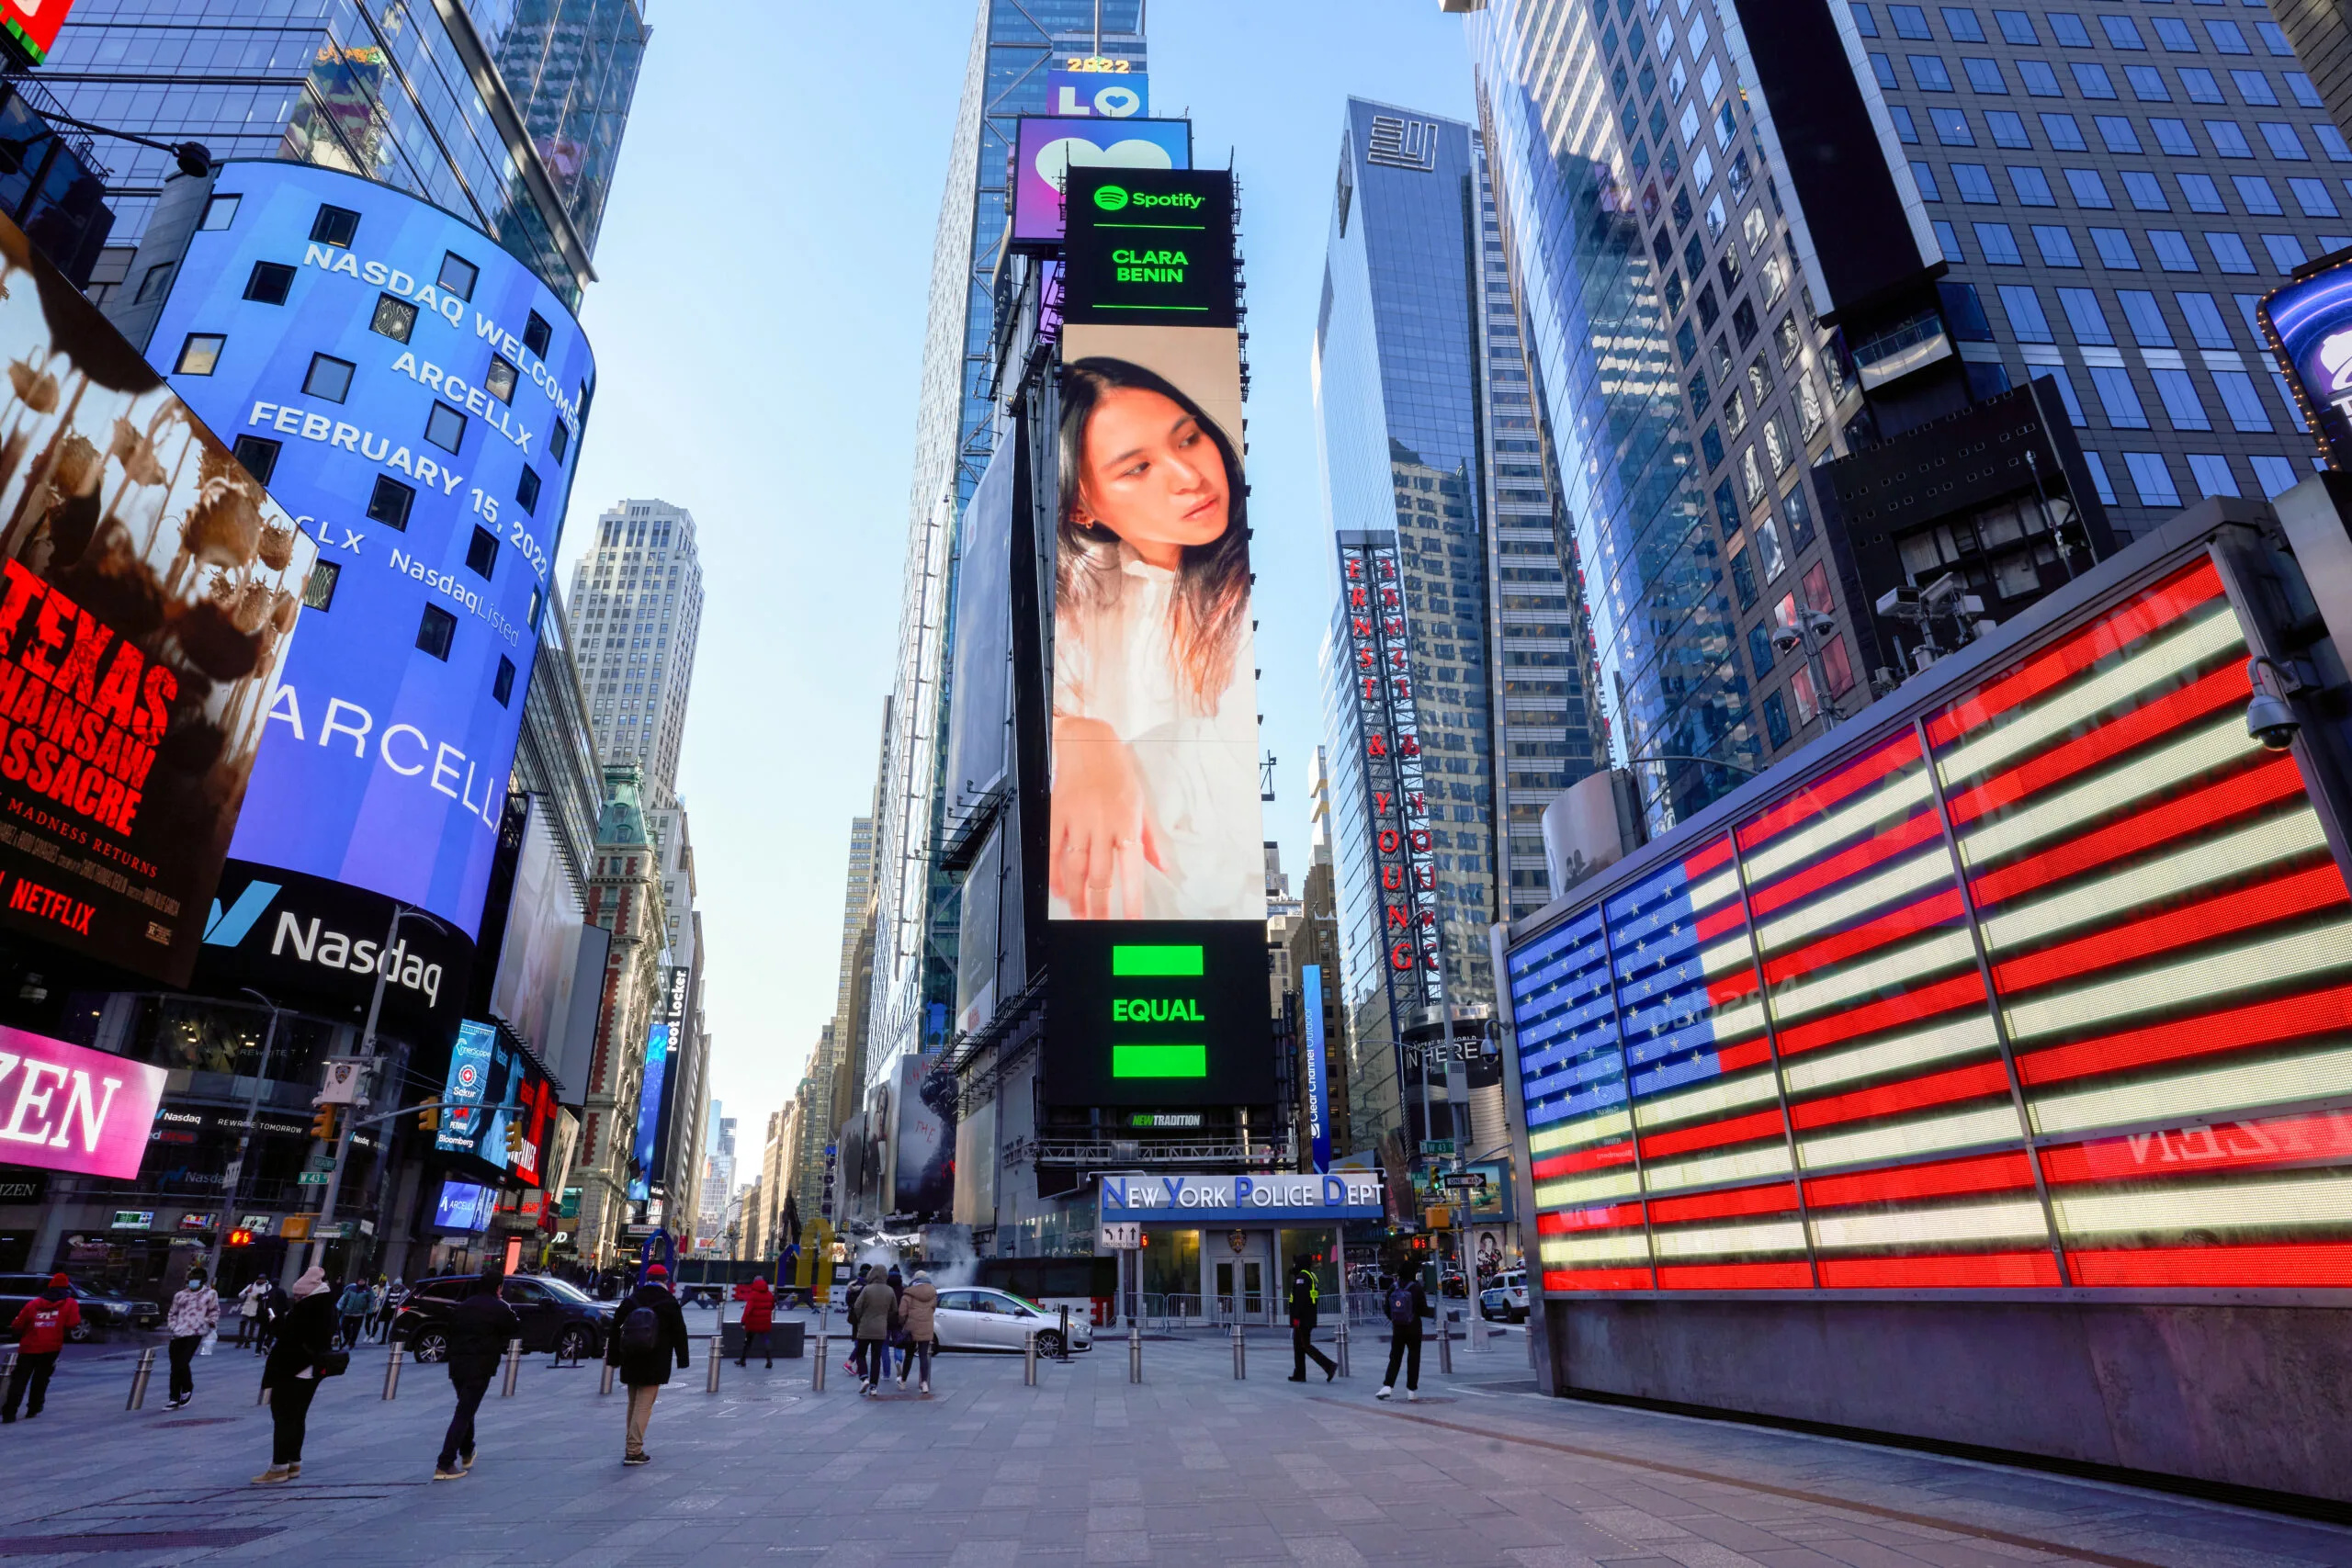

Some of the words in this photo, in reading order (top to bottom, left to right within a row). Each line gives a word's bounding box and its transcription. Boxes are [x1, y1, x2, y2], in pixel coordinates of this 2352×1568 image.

[1067, 57, 1130, 74] 2022
[1132, 193, 1202, 209] Spotify
[1112, 249, 1189, 265] CLARA
[1117, 267, 1183, 283] BENIN
[303, 243, 464, 328] NASDAQ
[475, 311, 581, 442] WELCOMES
[390, 352, 533, 455] ARCELLX
[248, 400, 463, 496] FEBRUARY
[470, 488, 503, 534] 15,
[510, 521, 550, 583] 2022
[1349, 558, 1377, 699] ERNST
[0, 557, 178, 747] TEXAS
[1368, 733, 1386, 756] &
[0, 716, 142, 837] SSACRE
[7, 797, 88, 844] MADNESS
[92, 838, 158, 879] RETURNS
[1375, 793, 1412, 970] YOUNG
[9, 877, 96, 936] NETFLIX
[271, 910, 444, 1008] Nasdaq
[668, 970, 687, 1017] Locker.
[1113, 998, 1204, 1022] EQUAL
[1305, 1008, 1314, 1048] Outdoor
[1307, 1049, 1317, 1092] Channel
[164, 1112, 201, 1125] Nasdaq
[218, 1118, 255, 1129] REWRE
[260, 1122, 302, 1134] TOMORROW
[438, 1134, 474, 1148] Bloomberg
[185, 1171, 224, 1185] Nasda
[300, 1174, 307, 1183] W
[310, 1174, 320, 1183] 43
[1103, 1176, 1159, 1210] NEW
[1162, 1177, 1227, 1209] YORK
[1236, 1176, 1313, 1208] POLICE
[1323, 1175, 1385, 1207] DEPT
[551, 1231, 568, 1244] JD
[1142, 1235, 1148, 1246] 6
